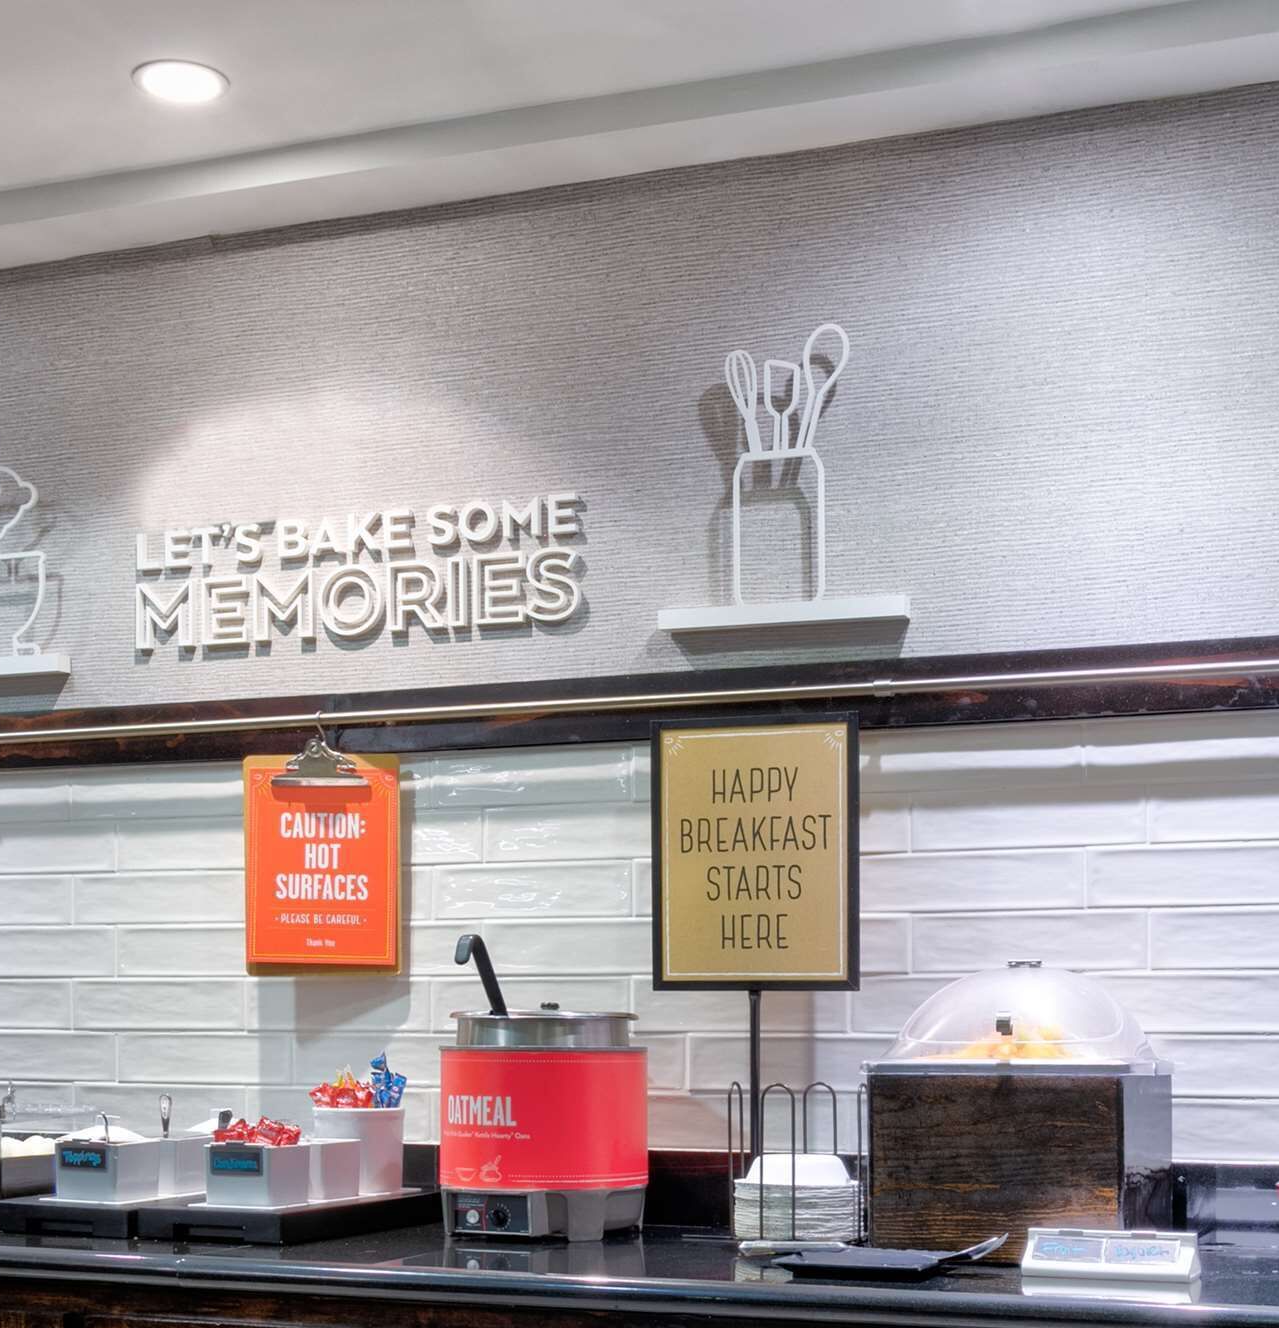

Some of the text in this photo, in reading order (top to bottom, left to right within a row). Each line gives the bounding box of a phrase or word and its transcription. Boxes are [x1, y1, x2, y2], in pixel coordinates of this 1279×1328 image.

[135, 492, 580, 571] LET'S BAKE SOME
[135, 547, 582, 650] MEMORIES
[711, 766, 798, 804] HAPPY
[280, 812, 366, 839] CAUTION:
[680, 814, 832, 853] BREAKFAST
[304, 843, 341, 869] HOT
[275, 873, 368, 900] SURFACES
[706, 864, 802, 901] STARTS
[280, 913, 361, 924] PLEASE BE CAREFUL
[721, 914, 789, 949] HERE
[448, 1095, 518, 1127] OATMEAL
